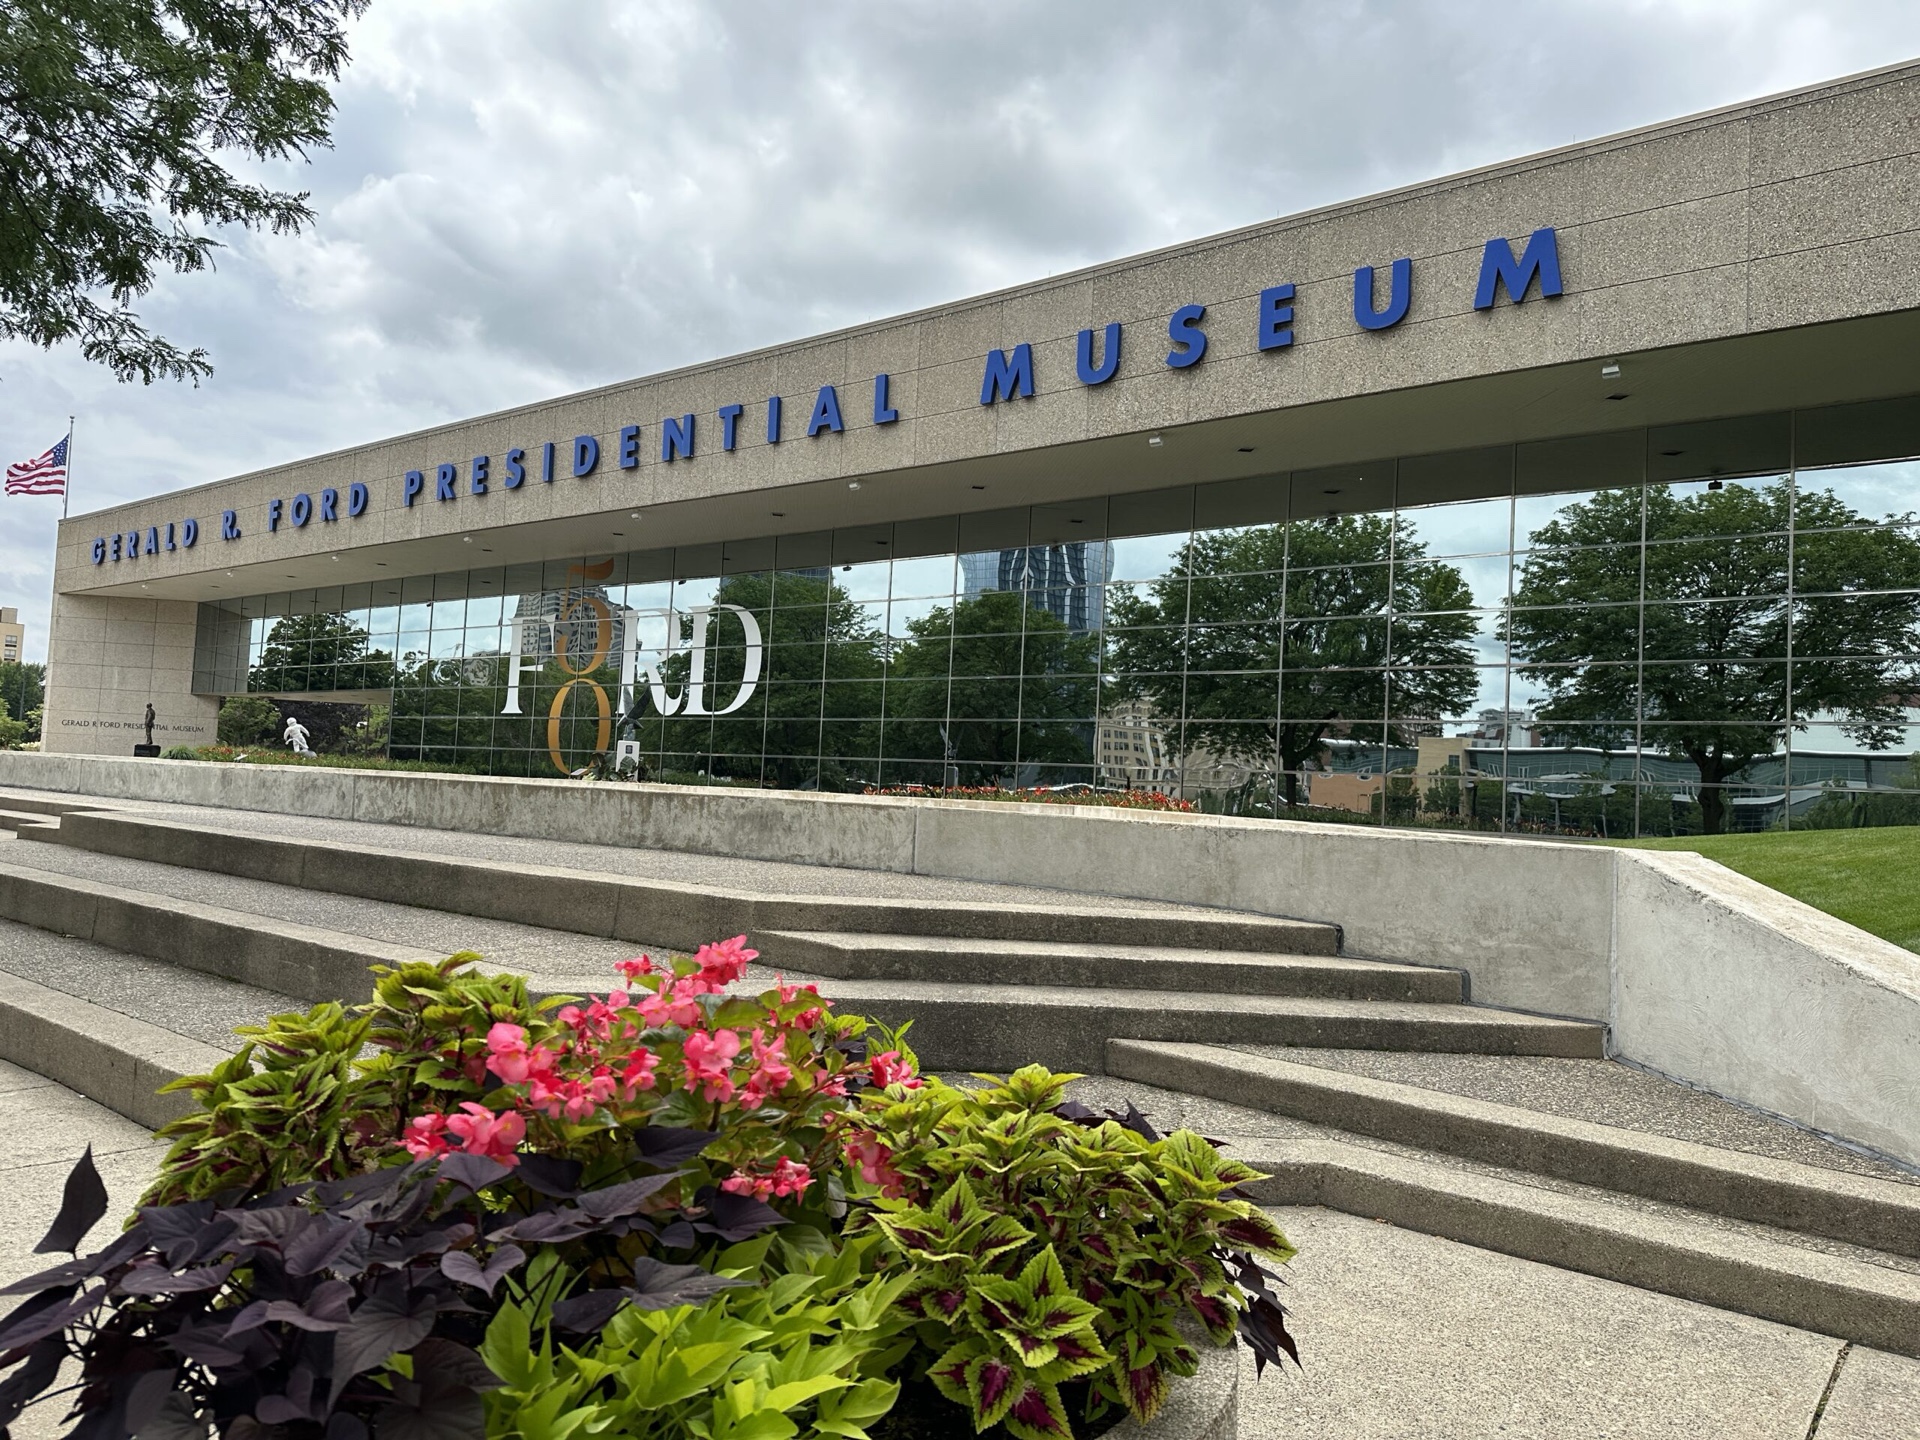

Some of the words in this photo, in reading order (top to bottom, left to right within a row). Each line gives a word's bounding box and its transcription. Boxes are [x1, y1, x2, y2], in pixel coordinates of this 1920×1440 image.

[91, 518, 198, 565] GERALD
[221, 509, 241, 541] R.
[268, 483, 369, 532] FORD
[403, 373, 899, 507] PRESIDENTIAL
[980, 227, 1564, 405] MUSEUM
[61, 719, 90, 728] GERALD
[100, 721, 121, 729] FORD
[172, 725, 204, 733] MUSEUM
